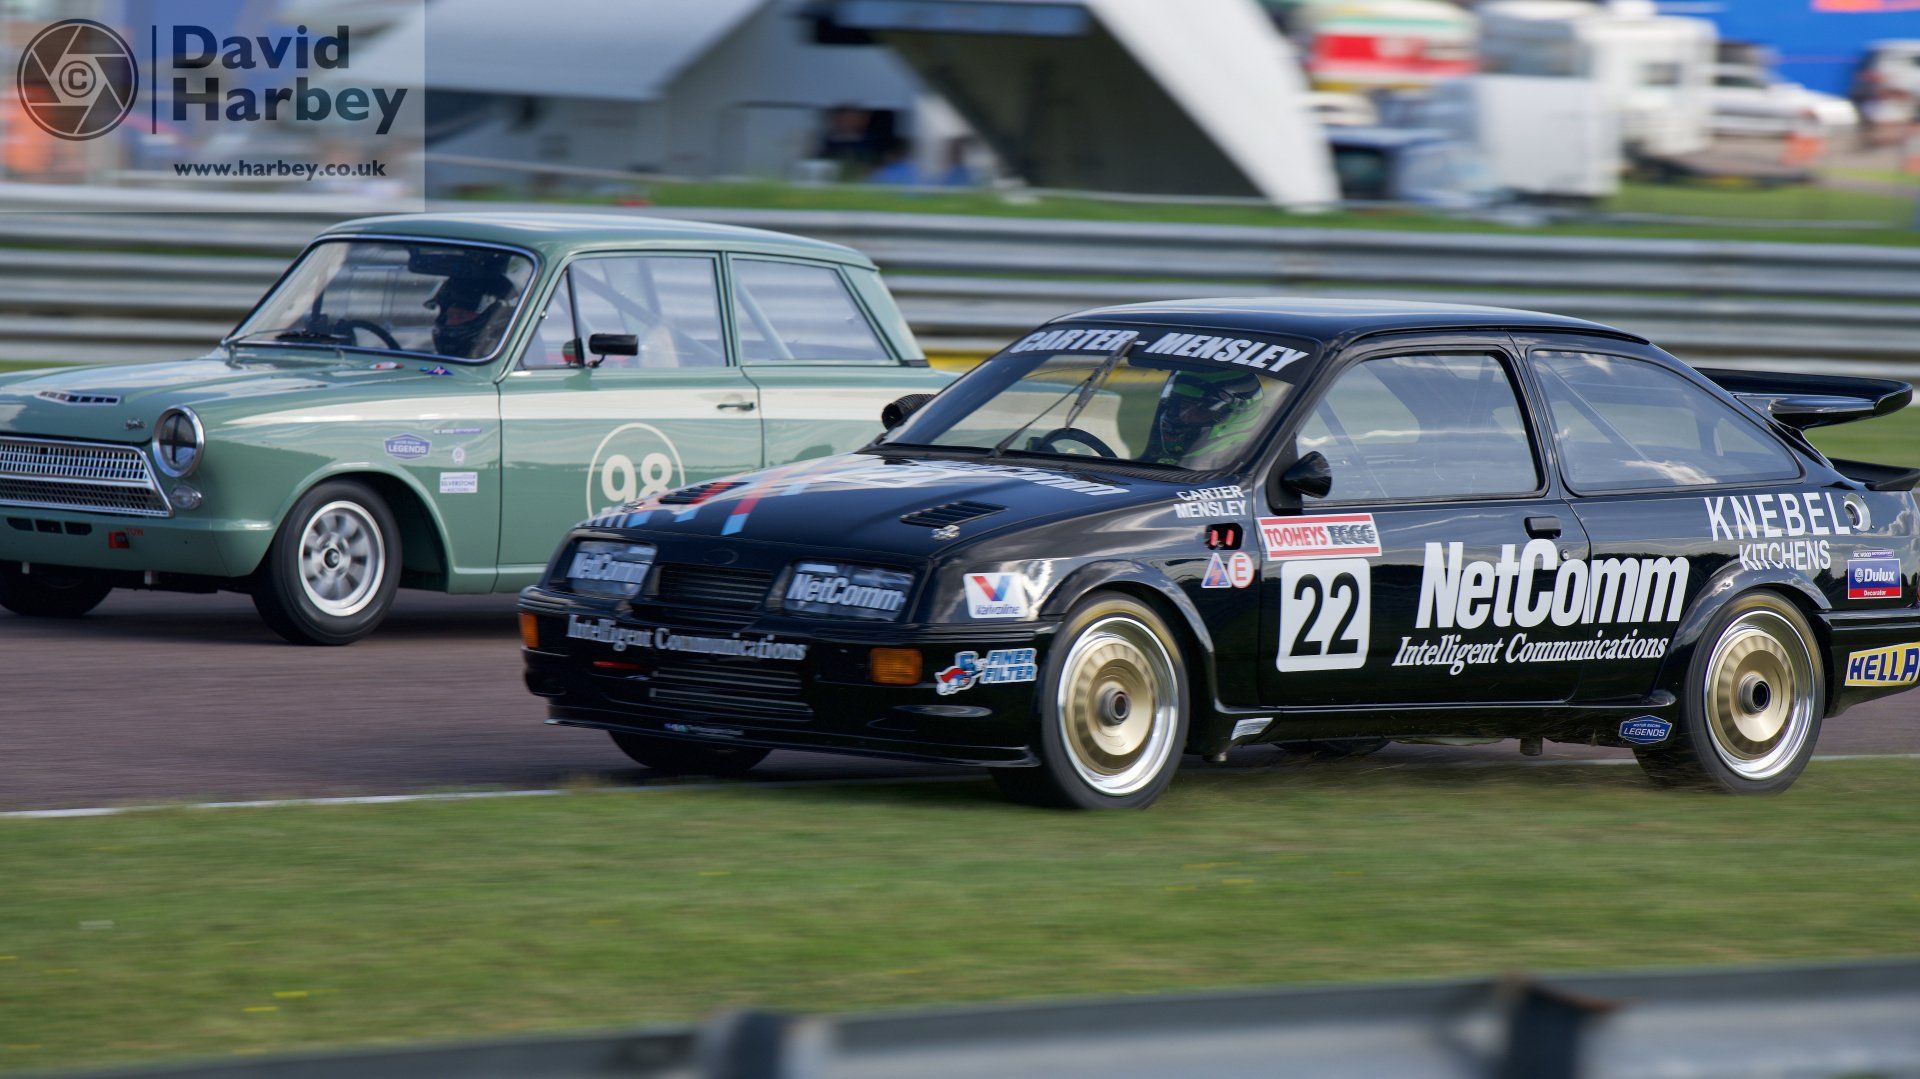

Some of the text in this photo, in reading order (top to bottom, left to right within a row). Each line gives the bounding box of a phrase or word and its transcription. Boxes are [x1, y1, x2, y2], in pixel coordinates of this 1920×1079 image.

[1010, 329, 1139, 353] CARTER
[1145, 332, 1309, 372] MENSLEY
[388, 445, 426, 454] LEGENDS
[602, 452, 672, 508] 98
[1176, 485, 1244, 501] CARTER
[1174, 500, 1246, 519] MENSLEY
[1704, 492, 1850, 541] KNEBEL
[1264, 526, 1327, 548] TOOHEYS
[566, 552, 649, 585] NetComm
[1234, 558, 1248, 581] E
[1739, 540, 1831, 571] KITCHENS
[1415, 538, 1690, 630] NetComm
[1864, 567, 1894, 581] Dulux
[785, 573, 905, 611] NetComm
[1289, 572, 1359, 656] 22
[567, 614, 808, 660] Intelligent Communications
[1392, 628, 1669, 676] Intelligent Communications
[984, 665, 1033, 682] FILTER
[1850, 647, 1920, 682] HELLA
[1624, 728, 1665, 736] LEGENDS
